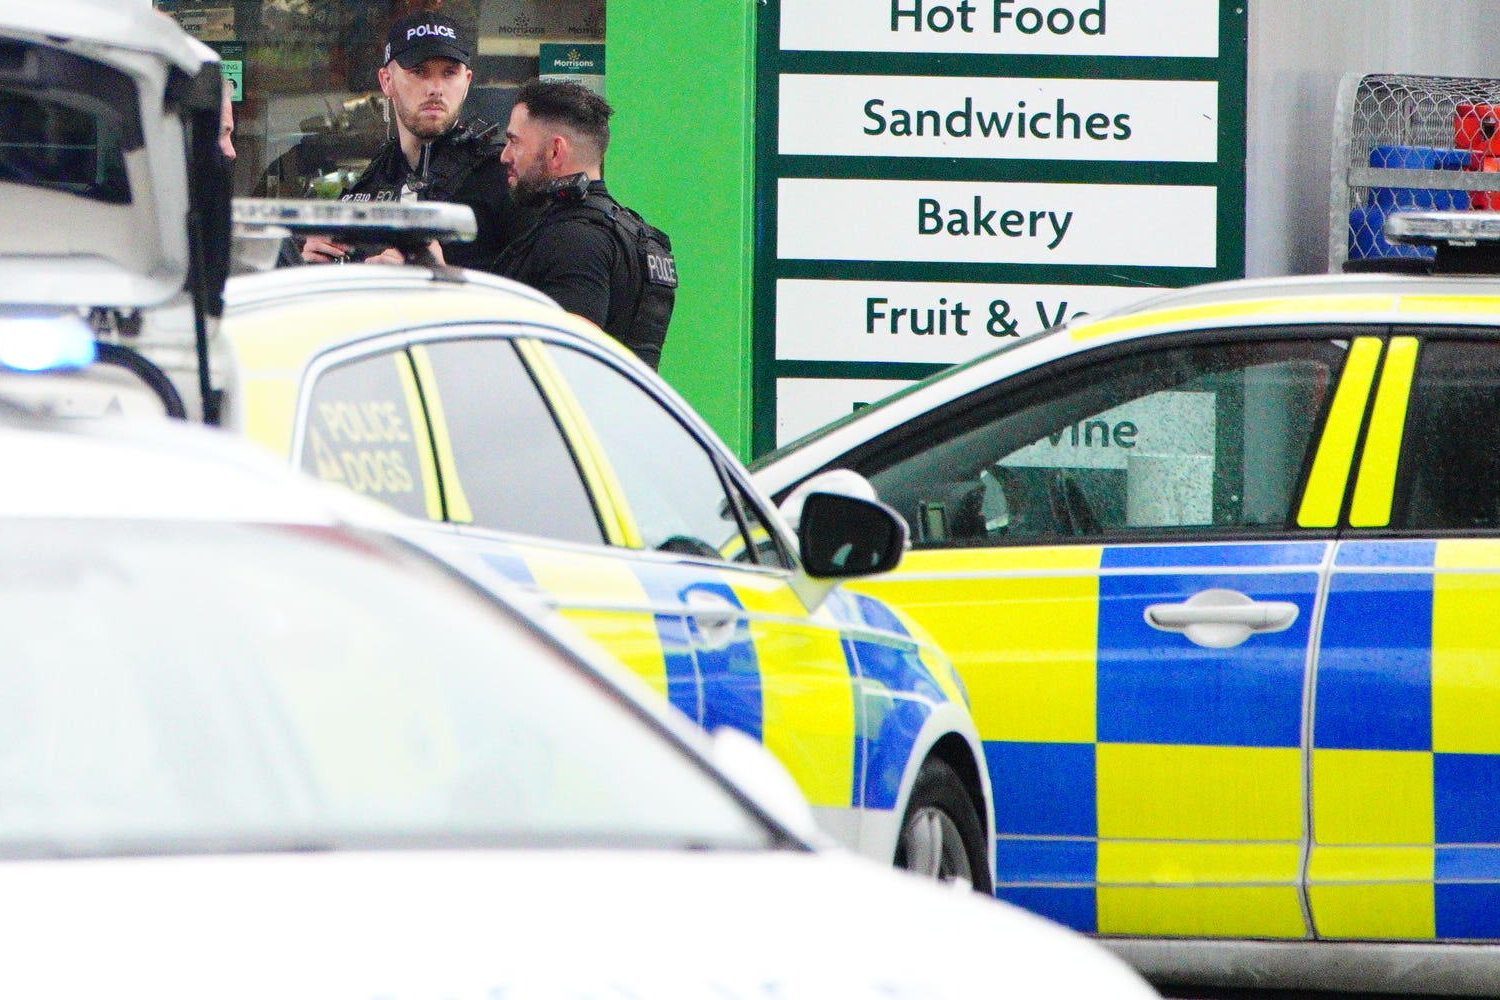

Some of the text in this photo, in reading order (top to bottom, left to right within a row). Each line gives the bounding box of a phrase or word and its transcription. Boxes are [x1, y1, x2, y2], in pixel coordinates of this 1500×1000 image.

[406, 23, 457, 41] POLICE
[554, 59, 594, 68] Morrisons
[862, 99, 1133, 142] Sandwiches
[916, 198, 1074, 250] Bakery
[647, 254, 676, 283] POLICE
[865, 297, 974, 337] Fruit
[985, 298, 1021, 338] &
[318, 401, 410, 442] POLICE
[340, 449, 414, 493] DOGS
